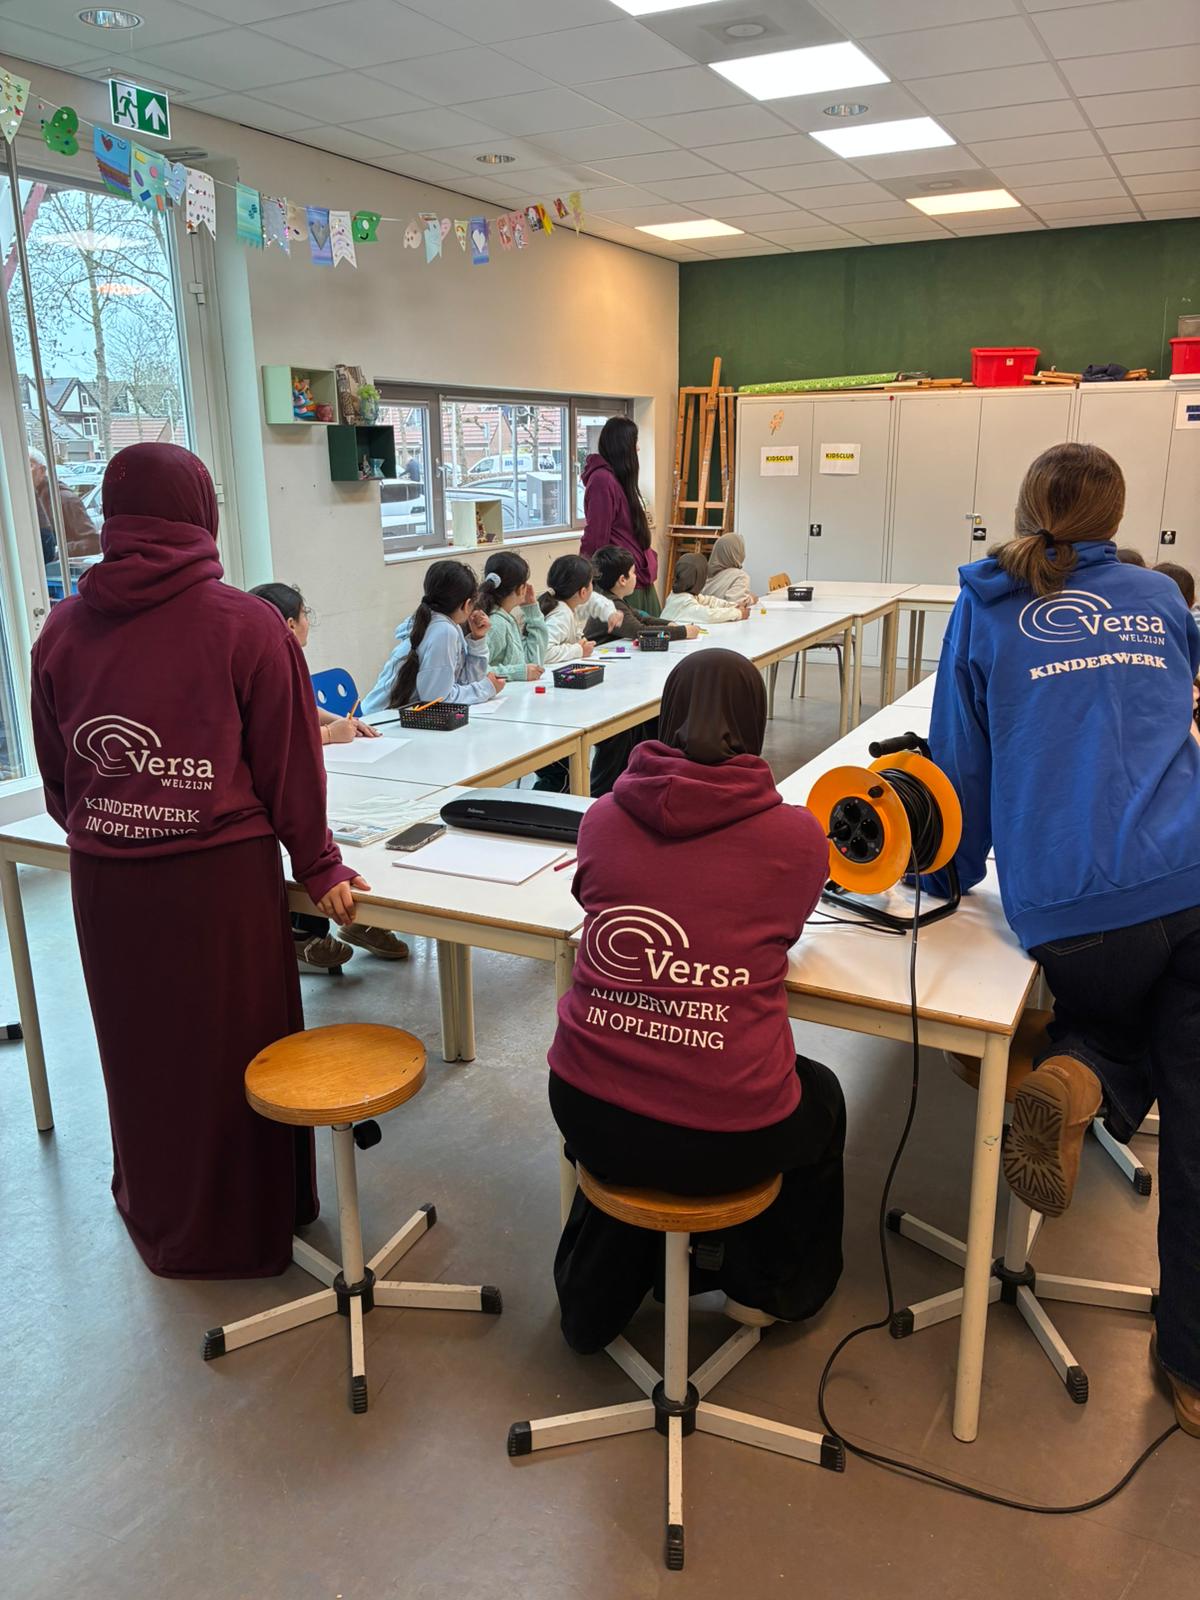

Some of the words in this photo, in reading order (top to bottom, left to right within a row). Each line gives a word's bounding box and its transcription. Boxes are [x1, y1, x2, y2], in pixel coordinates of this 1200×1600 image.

[1078, 614, 1166, 636] Versa
[1119, 634, 1165, 645] WELZIJN
[1029, 652, 1168, 680] KINDERWERK
[125, 750, 214, 778] Versa
[160, 778, 213, 790] WELZIJN
[84, 797, 200, 823] KINDERWERK
[85, 816, 102, 831] IN
[645, 948, 750, 988] Versa
[585, 1006, 608, 1027] IN
[609, 1012, 724, 1050] OPLEIDING
